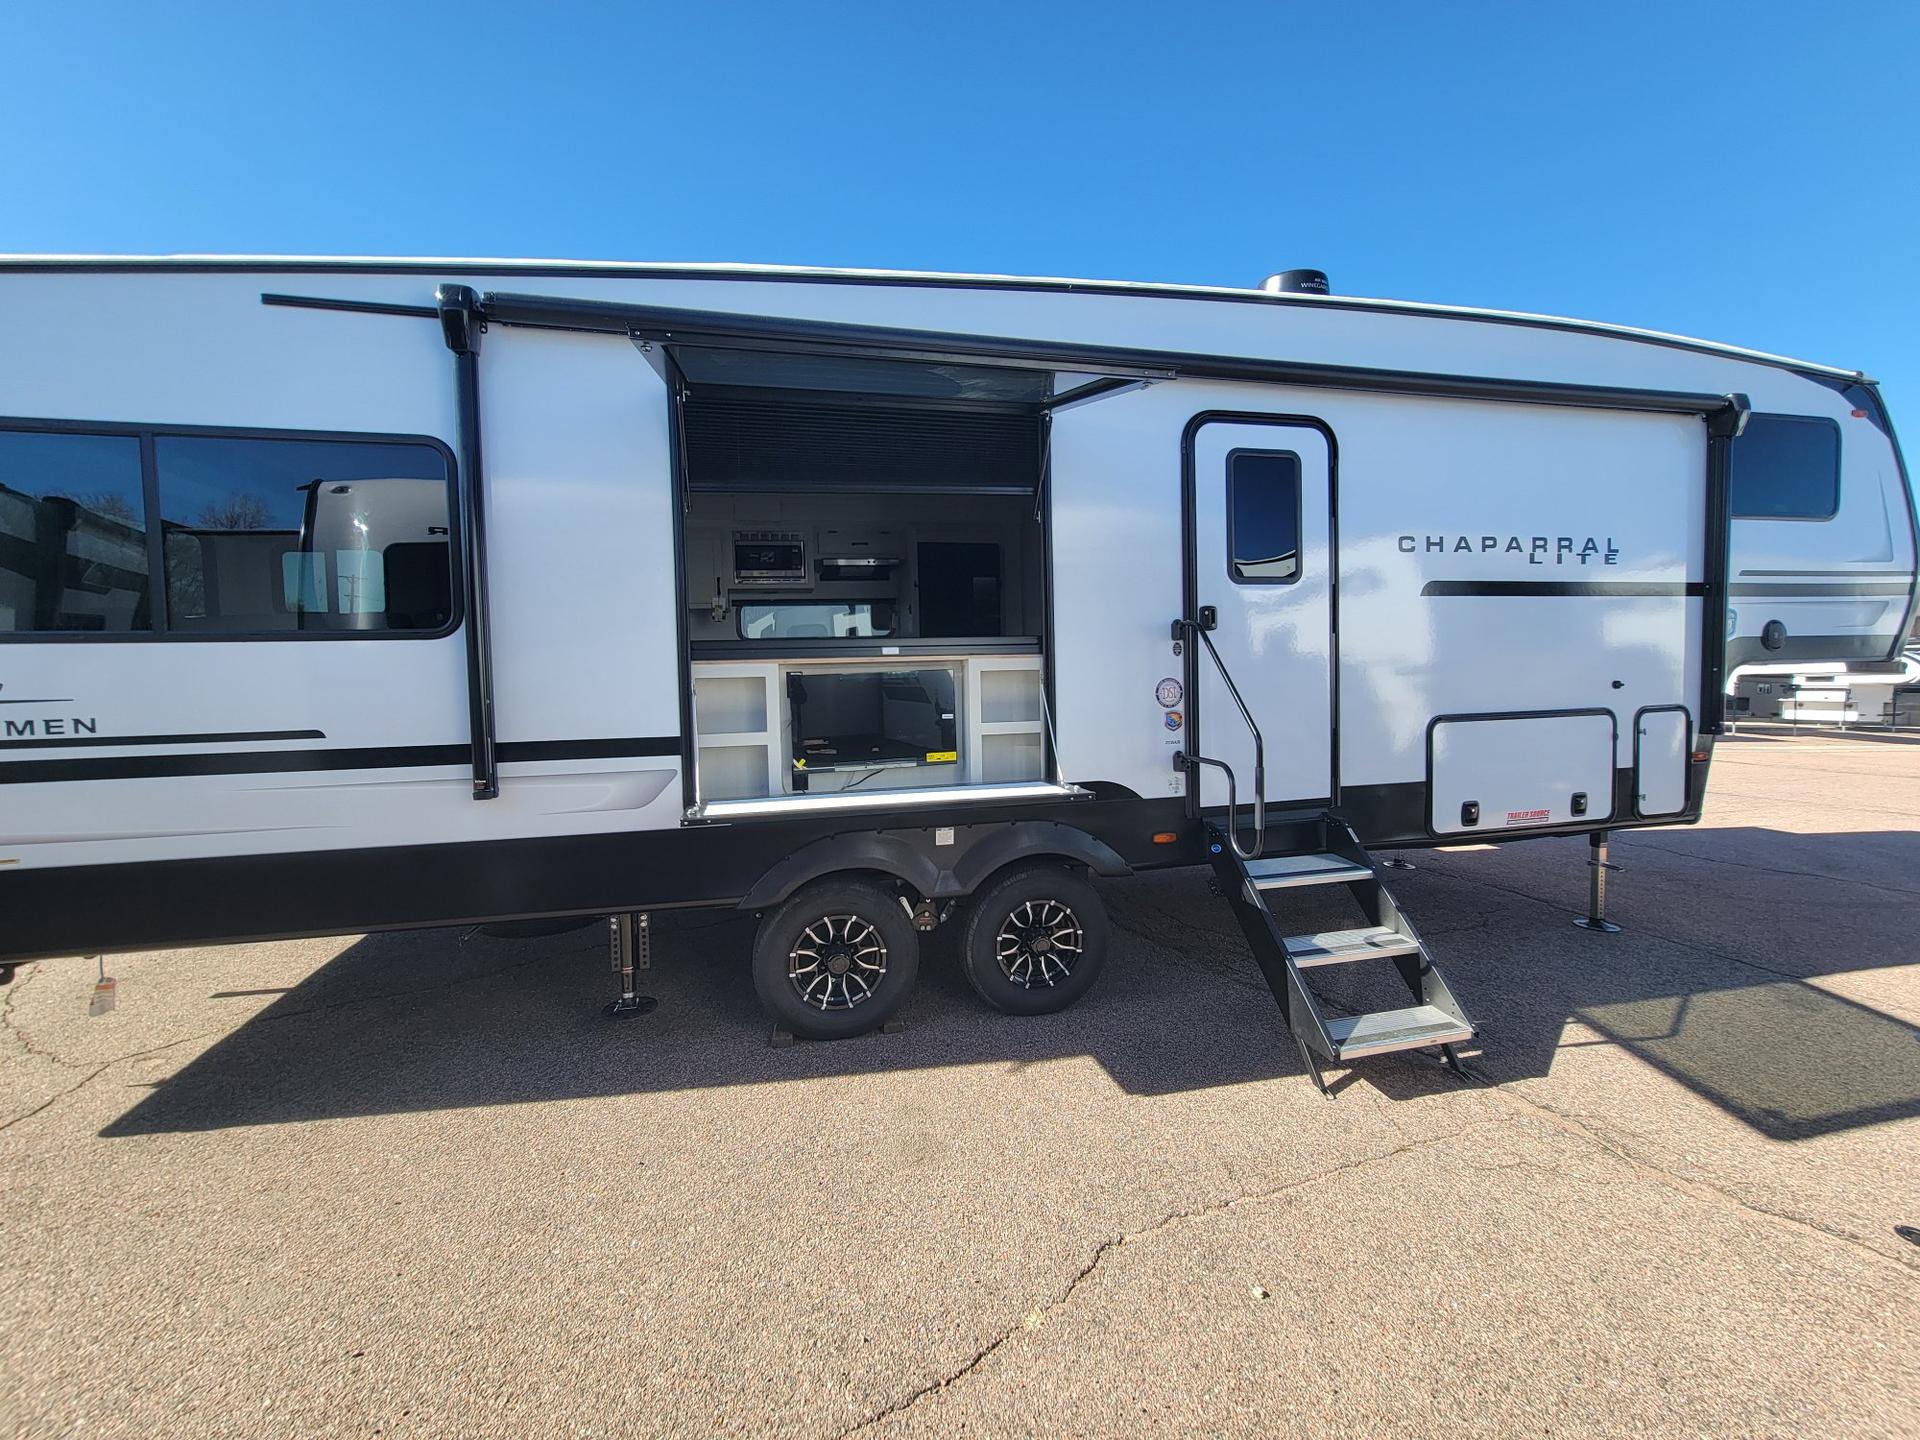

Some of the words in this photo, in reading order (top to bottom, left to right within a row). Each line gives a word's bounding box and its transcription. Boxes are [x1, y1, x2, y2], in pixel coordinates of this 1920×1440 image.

[1398, 536, 1619, 553] CHAPARRAL
[1529, 553, 1617, 565] LITE
[3, 718, 97, 736] MEN
[1507, 811, 1529, 819] TRAILER
